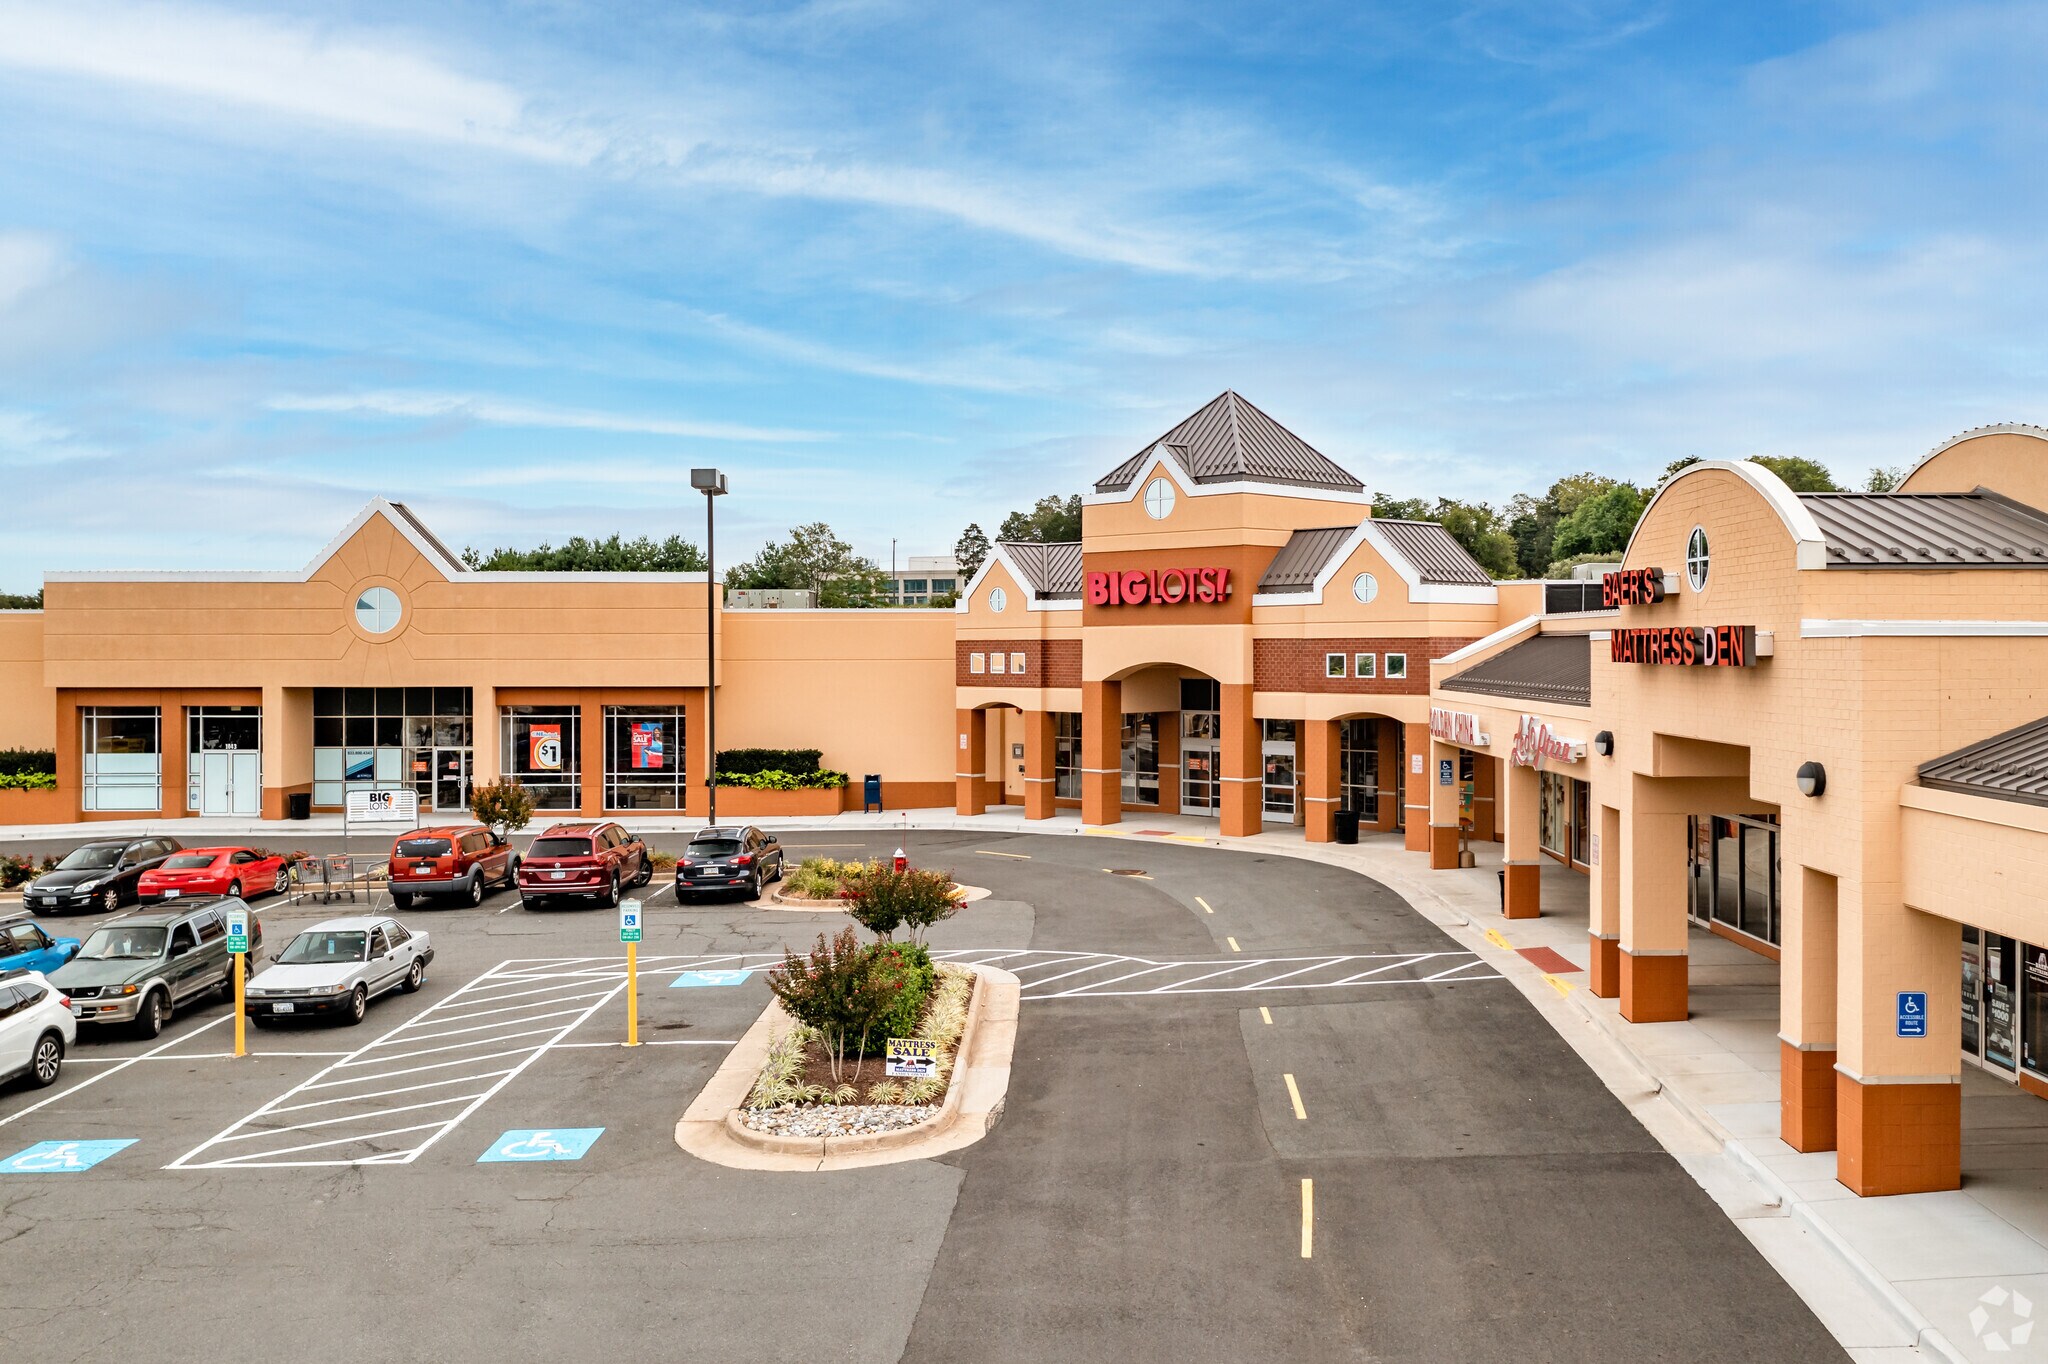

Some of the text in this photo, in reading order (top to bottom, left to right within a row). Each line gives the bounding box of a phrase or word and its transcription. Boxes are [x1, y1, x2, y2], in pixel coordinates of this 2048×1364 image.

[1087, 567, 1231, 605] BIG LOTS!
[1603, 567, 1664, 606] BAER'S
[1611, 626, 1755, 667] MATTRESS DEN
[1455, 712, 1475, 746] CHINA
[541, 745, 557, 762] $1
[369, 792, 391, 802] BIG
[1992, 999, 2005, 1010] SAVE
[889, 1040, 936, 1049] MATTRESS
[893, 1047, 931, 1057] SALE
